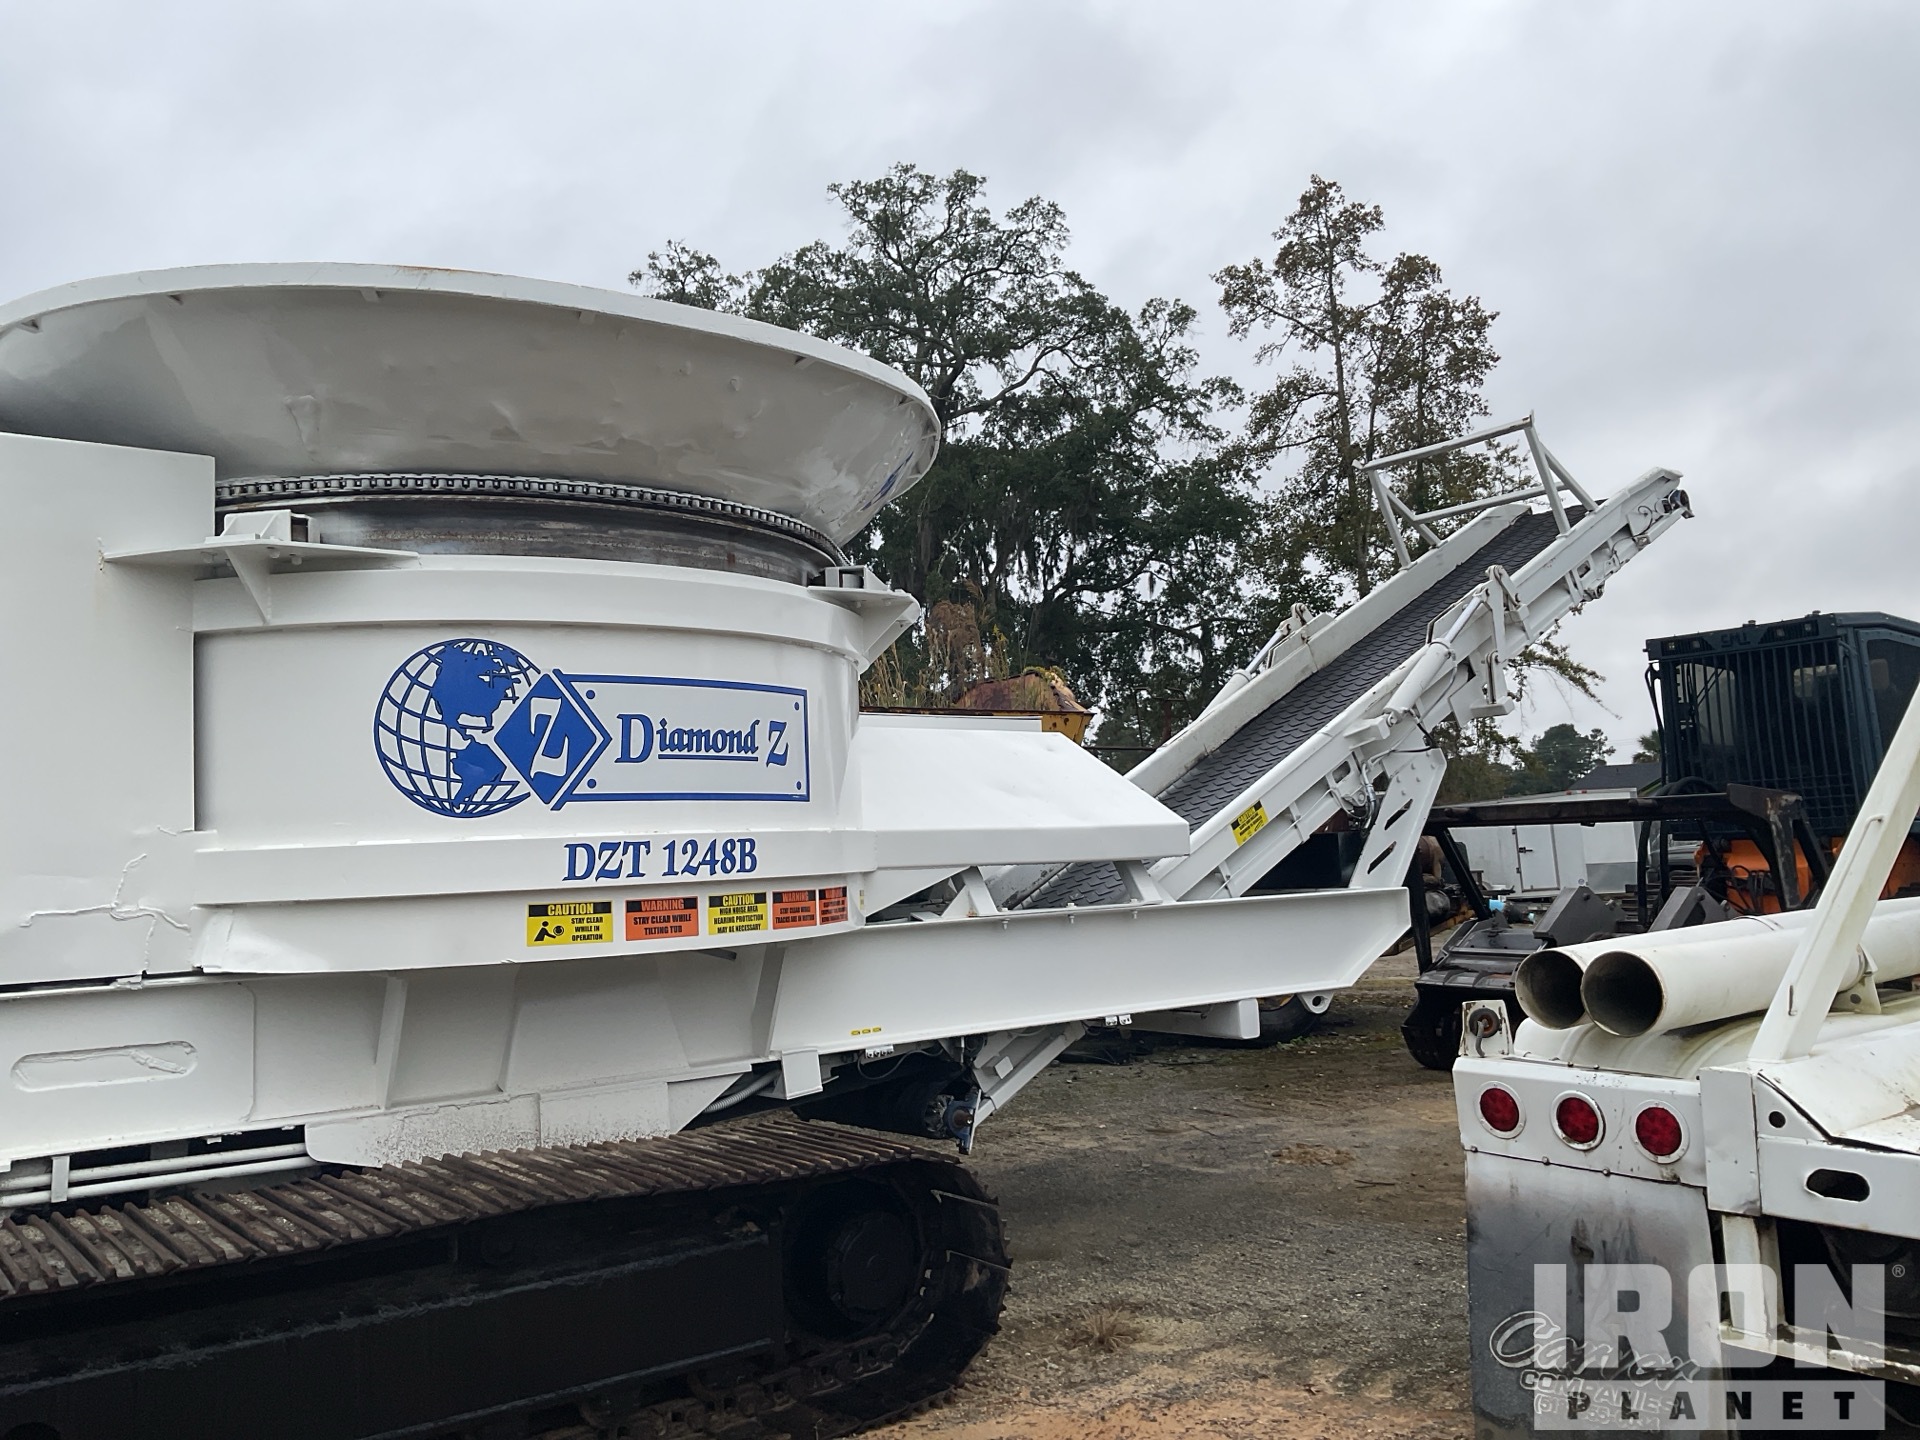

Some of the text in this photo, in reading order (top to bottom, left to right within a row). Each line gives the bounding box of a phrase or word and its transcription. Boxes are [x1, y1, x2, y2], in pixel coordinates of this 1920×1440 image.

[530, 697, 568, 780] Z
[614, 713, 789, 767] Diamond Z
[562, 837, 758, 882] DZT 1248B
[722, 893, 755, 906] CAUTION
[782, 890, 808, 902] WARNING
[547, 902, 594, 916] CAUTION
[641, 898, 684, 911] WARNING
[720, 907, 731, 915] HIGH
[732, 906, 746, 914] NOISE
[633, 913, 691, 925] STAY CLEAR WHILE
[713, 913, 763, 924] HEARING PROTECTION
[644, 925, 683, 935] TILTING TUB
[736, 924, 761, 932] NECESSARY
[572, 933, 603, 941] OPERATION
